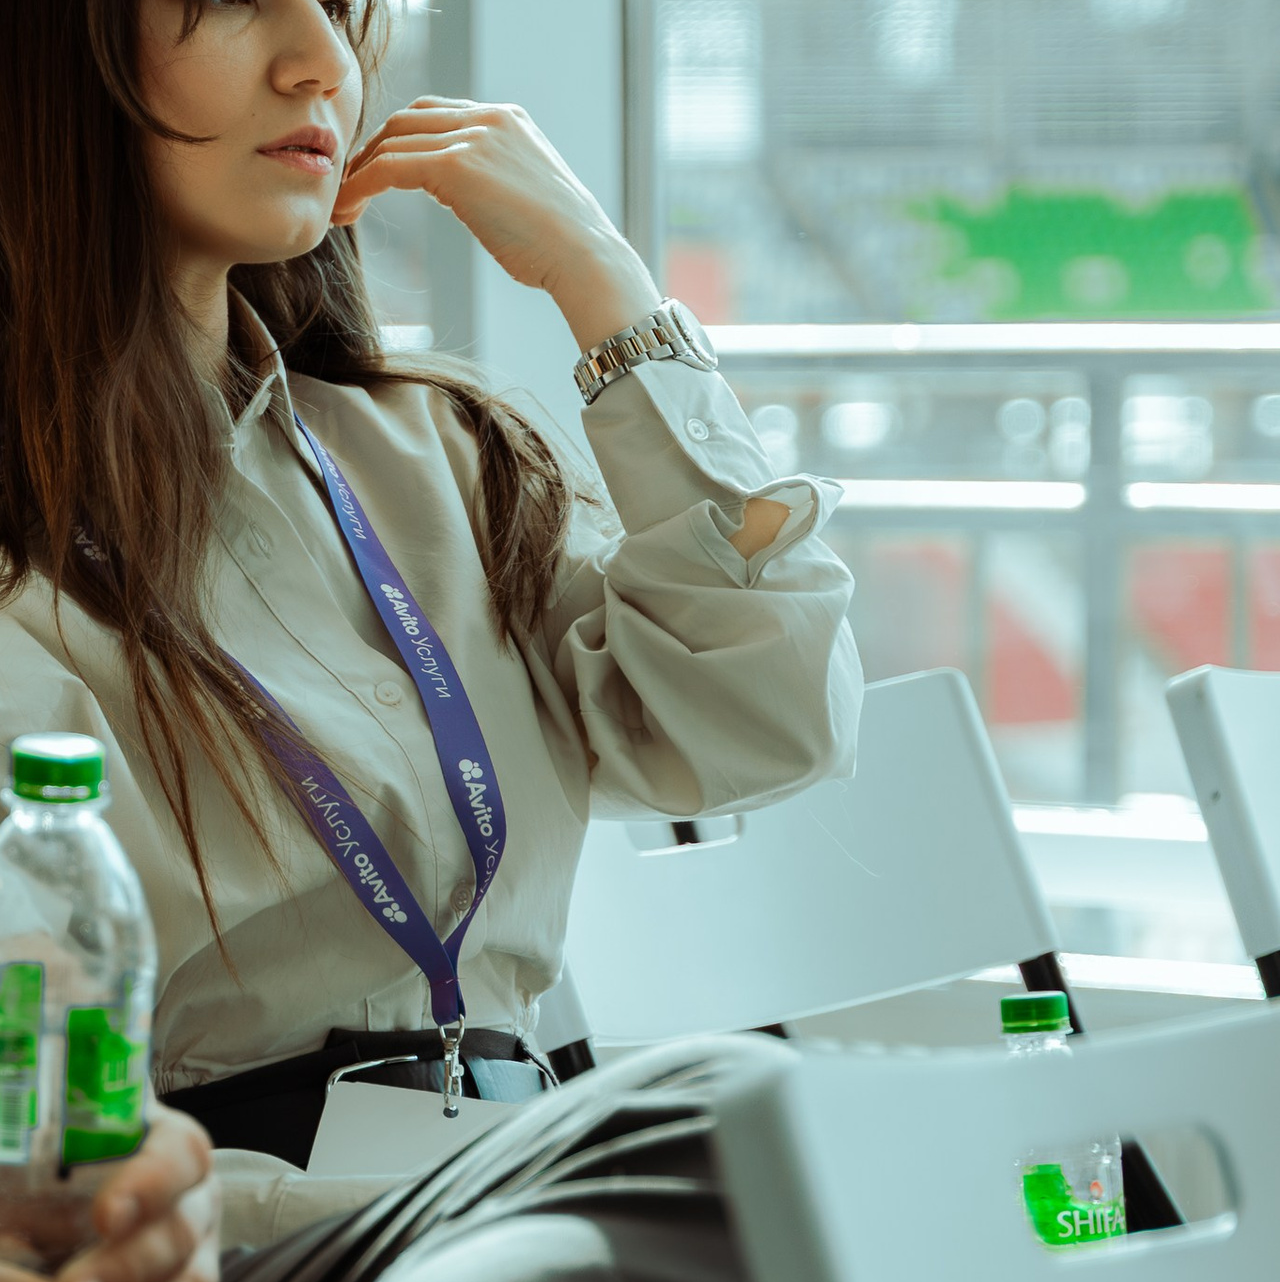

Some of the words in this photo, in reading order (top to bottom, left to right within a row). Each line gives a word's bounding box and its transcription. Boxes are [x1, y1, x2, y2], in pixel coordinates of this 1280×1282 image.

[334, 478, 367, 540] Услуги
[388, 597, 420, 636] Avito
[410, 636, 452, 698] Услуги
[301, 775, 360, 858] Услуги
[464, 781, 493, 837] Avito
[353, 853, 395, 904] Avito
